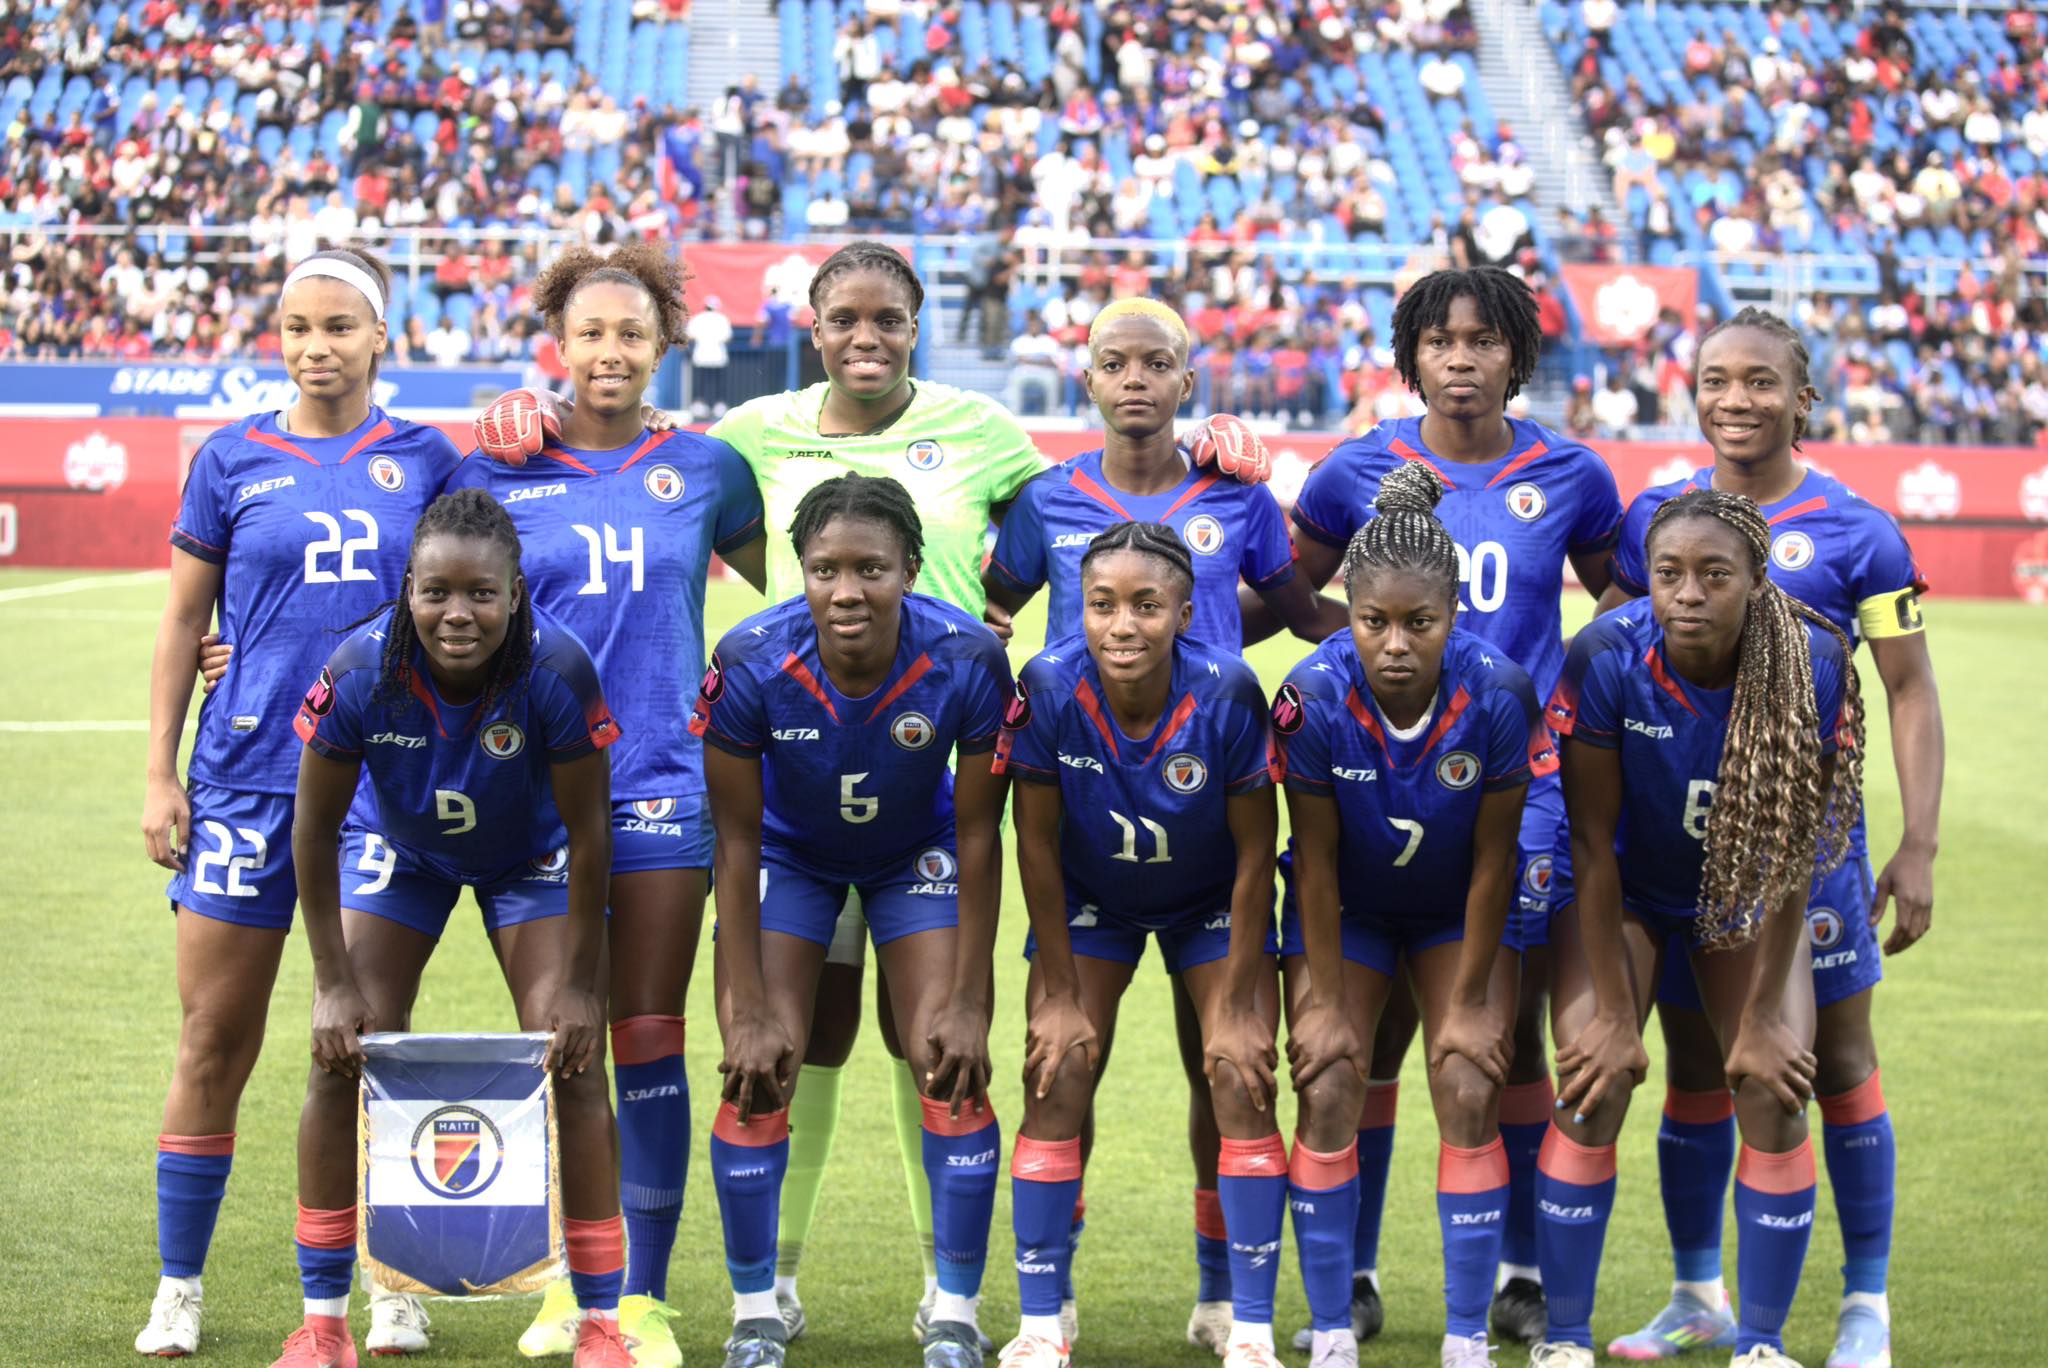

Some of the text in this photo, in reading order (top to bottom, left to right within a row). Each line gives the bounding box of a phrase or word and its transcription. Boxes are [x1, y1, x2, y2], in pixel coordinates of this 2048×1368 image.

[110, 367, 215, 394] STADE
[239, 475, 296, 503] SAETA
[503, 483, 567, 504] SAETA
[304, 510, 379, 584] 22
[1051, 533, 1104, 548] SAET
[571, 523, 644, 595] 14
[365, 731, 427, 749] SAETA
[771, 727, 819, 741] AETA
[1057, 750, 1104, 775] AETA
[1331, 764, 1377, 782] AETA
[840, 772, 879, 824] 5
[435, 789, 477, 835] 9
[620, 819, 683, 837] SAETA
[1108, 810, 1173, 863] 11
[1387, 816, 1425, 867] 7
[193, 820, 267, 896] 22
[352, 833, 397, 895] 9
[1811, 949, 1857, 970] AETA
[624, 1085, 679, 1101] SAETA
[439, 1121, 475, 1132] HAITI
